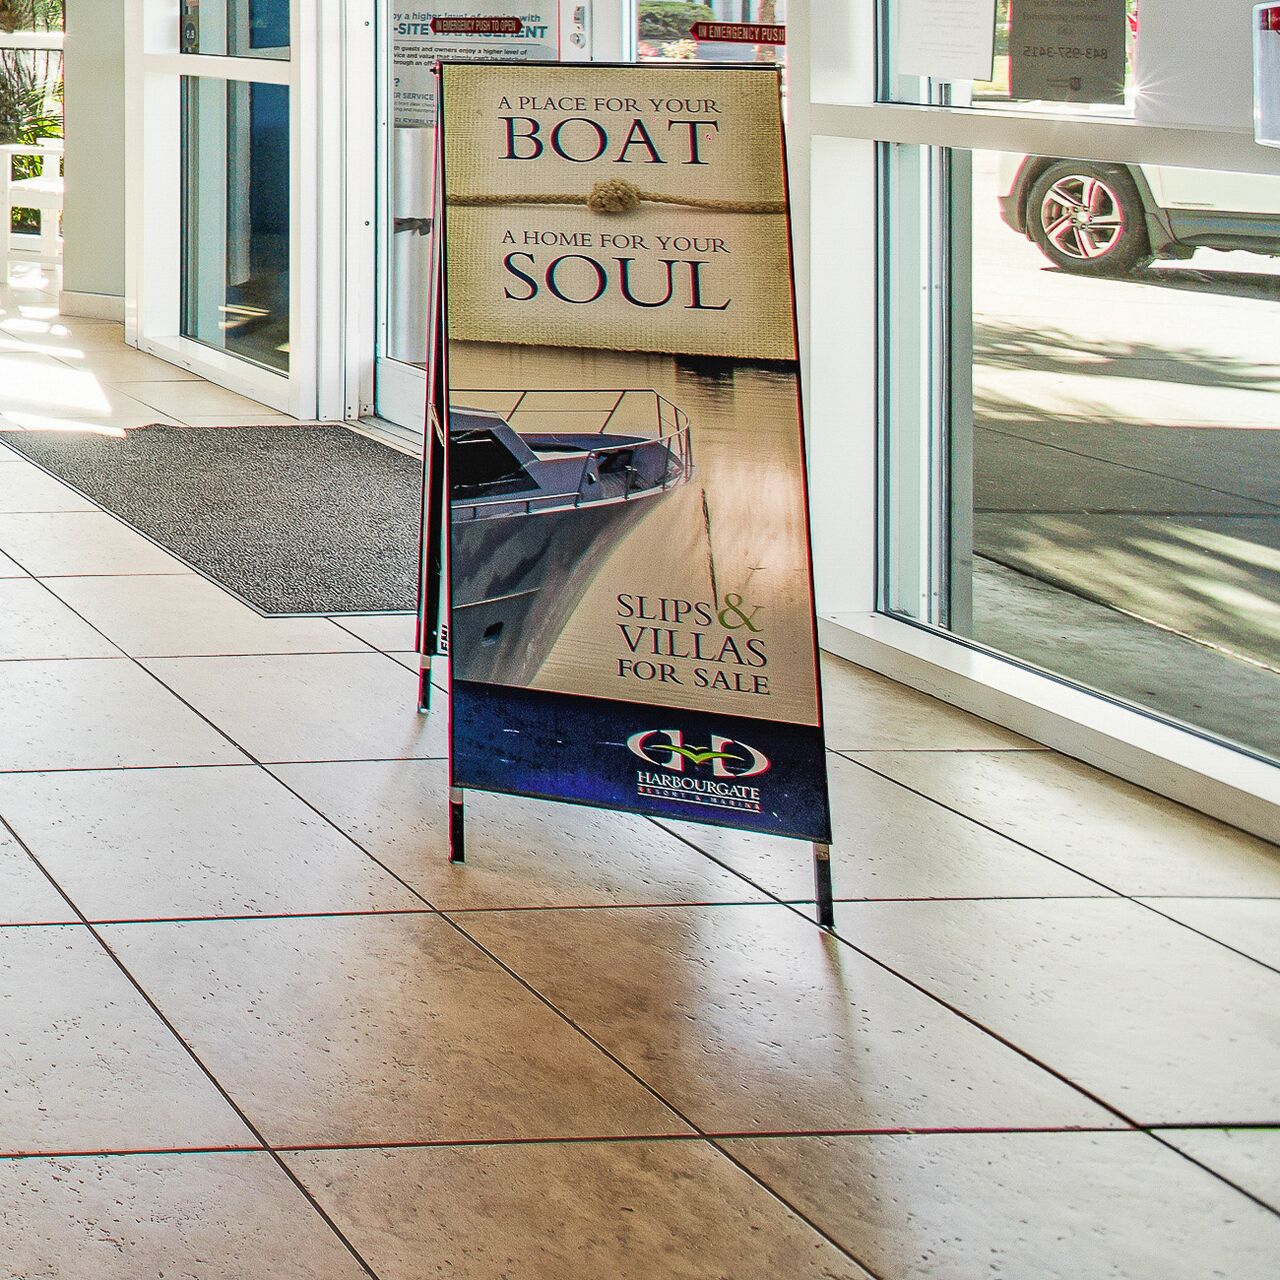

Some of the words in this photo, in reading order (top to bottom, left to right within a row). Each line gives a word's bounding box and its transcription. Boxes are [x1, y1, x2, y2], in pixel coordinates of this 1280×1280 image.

[393, 23, 429, 35] -SITE
[435, 20, 442, 30] IN
[443, 20, 474, 31] EMERGENCY
[476, 20, 491, 31] PUSH
[492, 20, 499, 31] TO
[500, 21, 516, 31] OPEN
[519, 13, 541, 22] with
[698, 25, 707, 37] IN
[708, 25, 759, 40] EMERGENCY
[761, 28, 785, 41] PUSH
[403, 92, 434, 100] SERVICE
[498, 96, 512, 110] A
[519, 96, 586, 111] PLACE
[594, 98, 642, 112] FOR
[648, 98, 722, 113] YOUR
[498, 117, 719, 165] BOAT
[502, 230, 516, 244] A
[523, 231, 592, 247] HOME
[600, 234, 650, 250] FOR
[656, 235, 731, 253] YOUR
[503, 251, 732, 310] SOUL
[616, 593, 712, 627] SLIPS
[718, 592, 765, 633] &
[616, 623, 768, 668] VILLAS
[617, 658, 684, 685] FOR
[693, 667, 770, 695] SALE
[637, 770, 760, 800] HARBOURGATE
[639, 786, 686, 798] RESORT
[710, 797, 761, 810] MARINA
